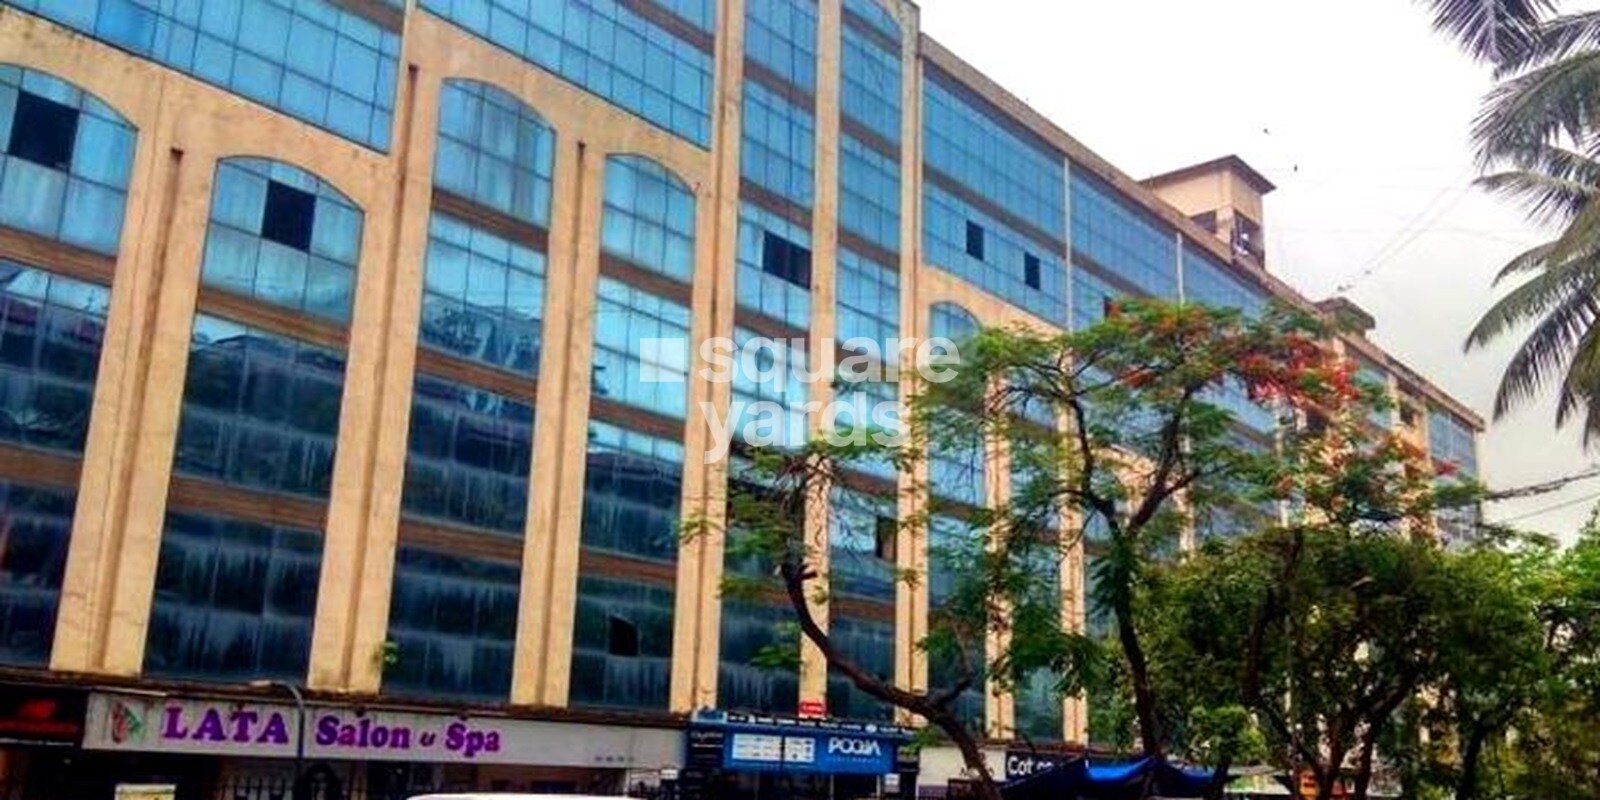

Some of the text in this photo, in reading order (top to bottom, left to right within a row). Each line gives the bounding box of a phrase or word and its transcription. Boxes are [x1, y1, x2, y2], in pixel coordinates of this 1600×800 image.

[163, 704, 289, 746] LATA
[314, 714, 411, 750] Salon
[446, 723, 501, 757] Spa
